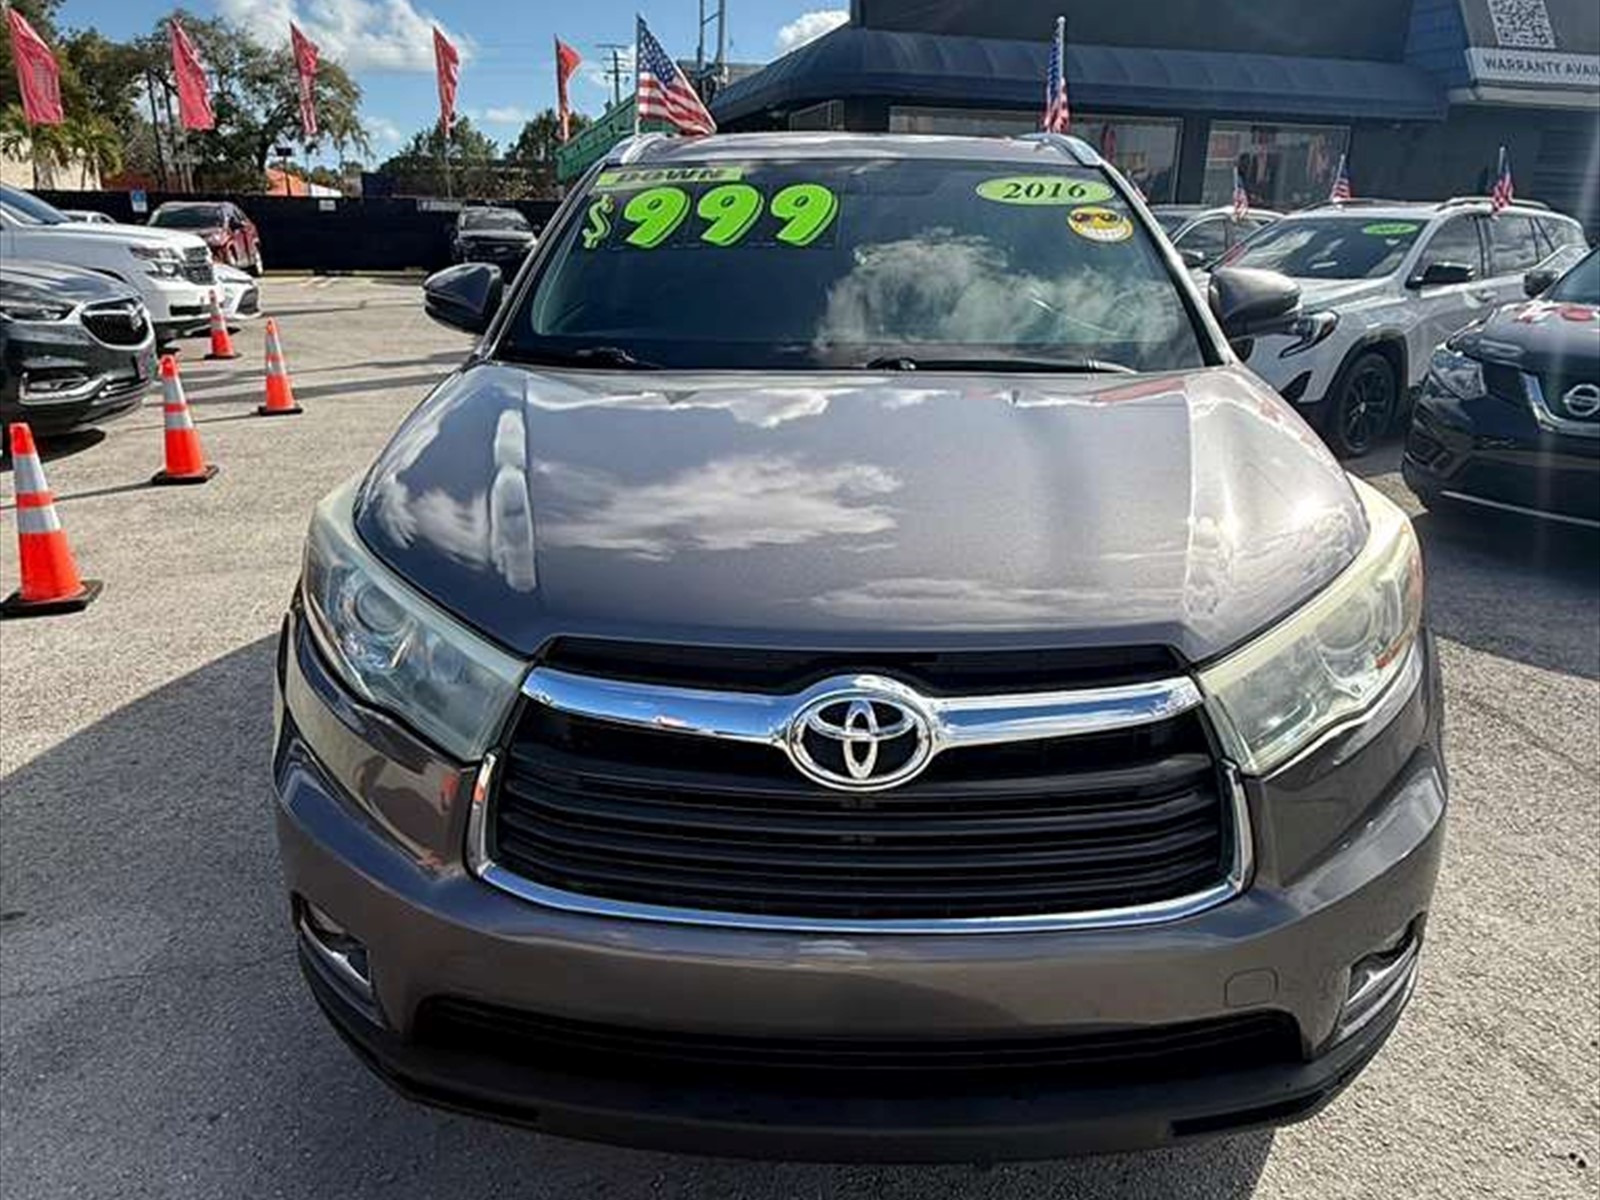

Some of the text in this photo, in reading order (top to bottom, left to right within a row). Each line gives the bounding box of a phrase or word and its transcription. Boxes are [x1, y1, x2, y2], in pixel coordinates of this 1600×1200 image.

[1482, 56, 1561, 75] WARRANTY
[616, 168, 720, 183] DOWN
[1002, 182, 1087, 199] 2016
[582, 184, 839, 249] $999
